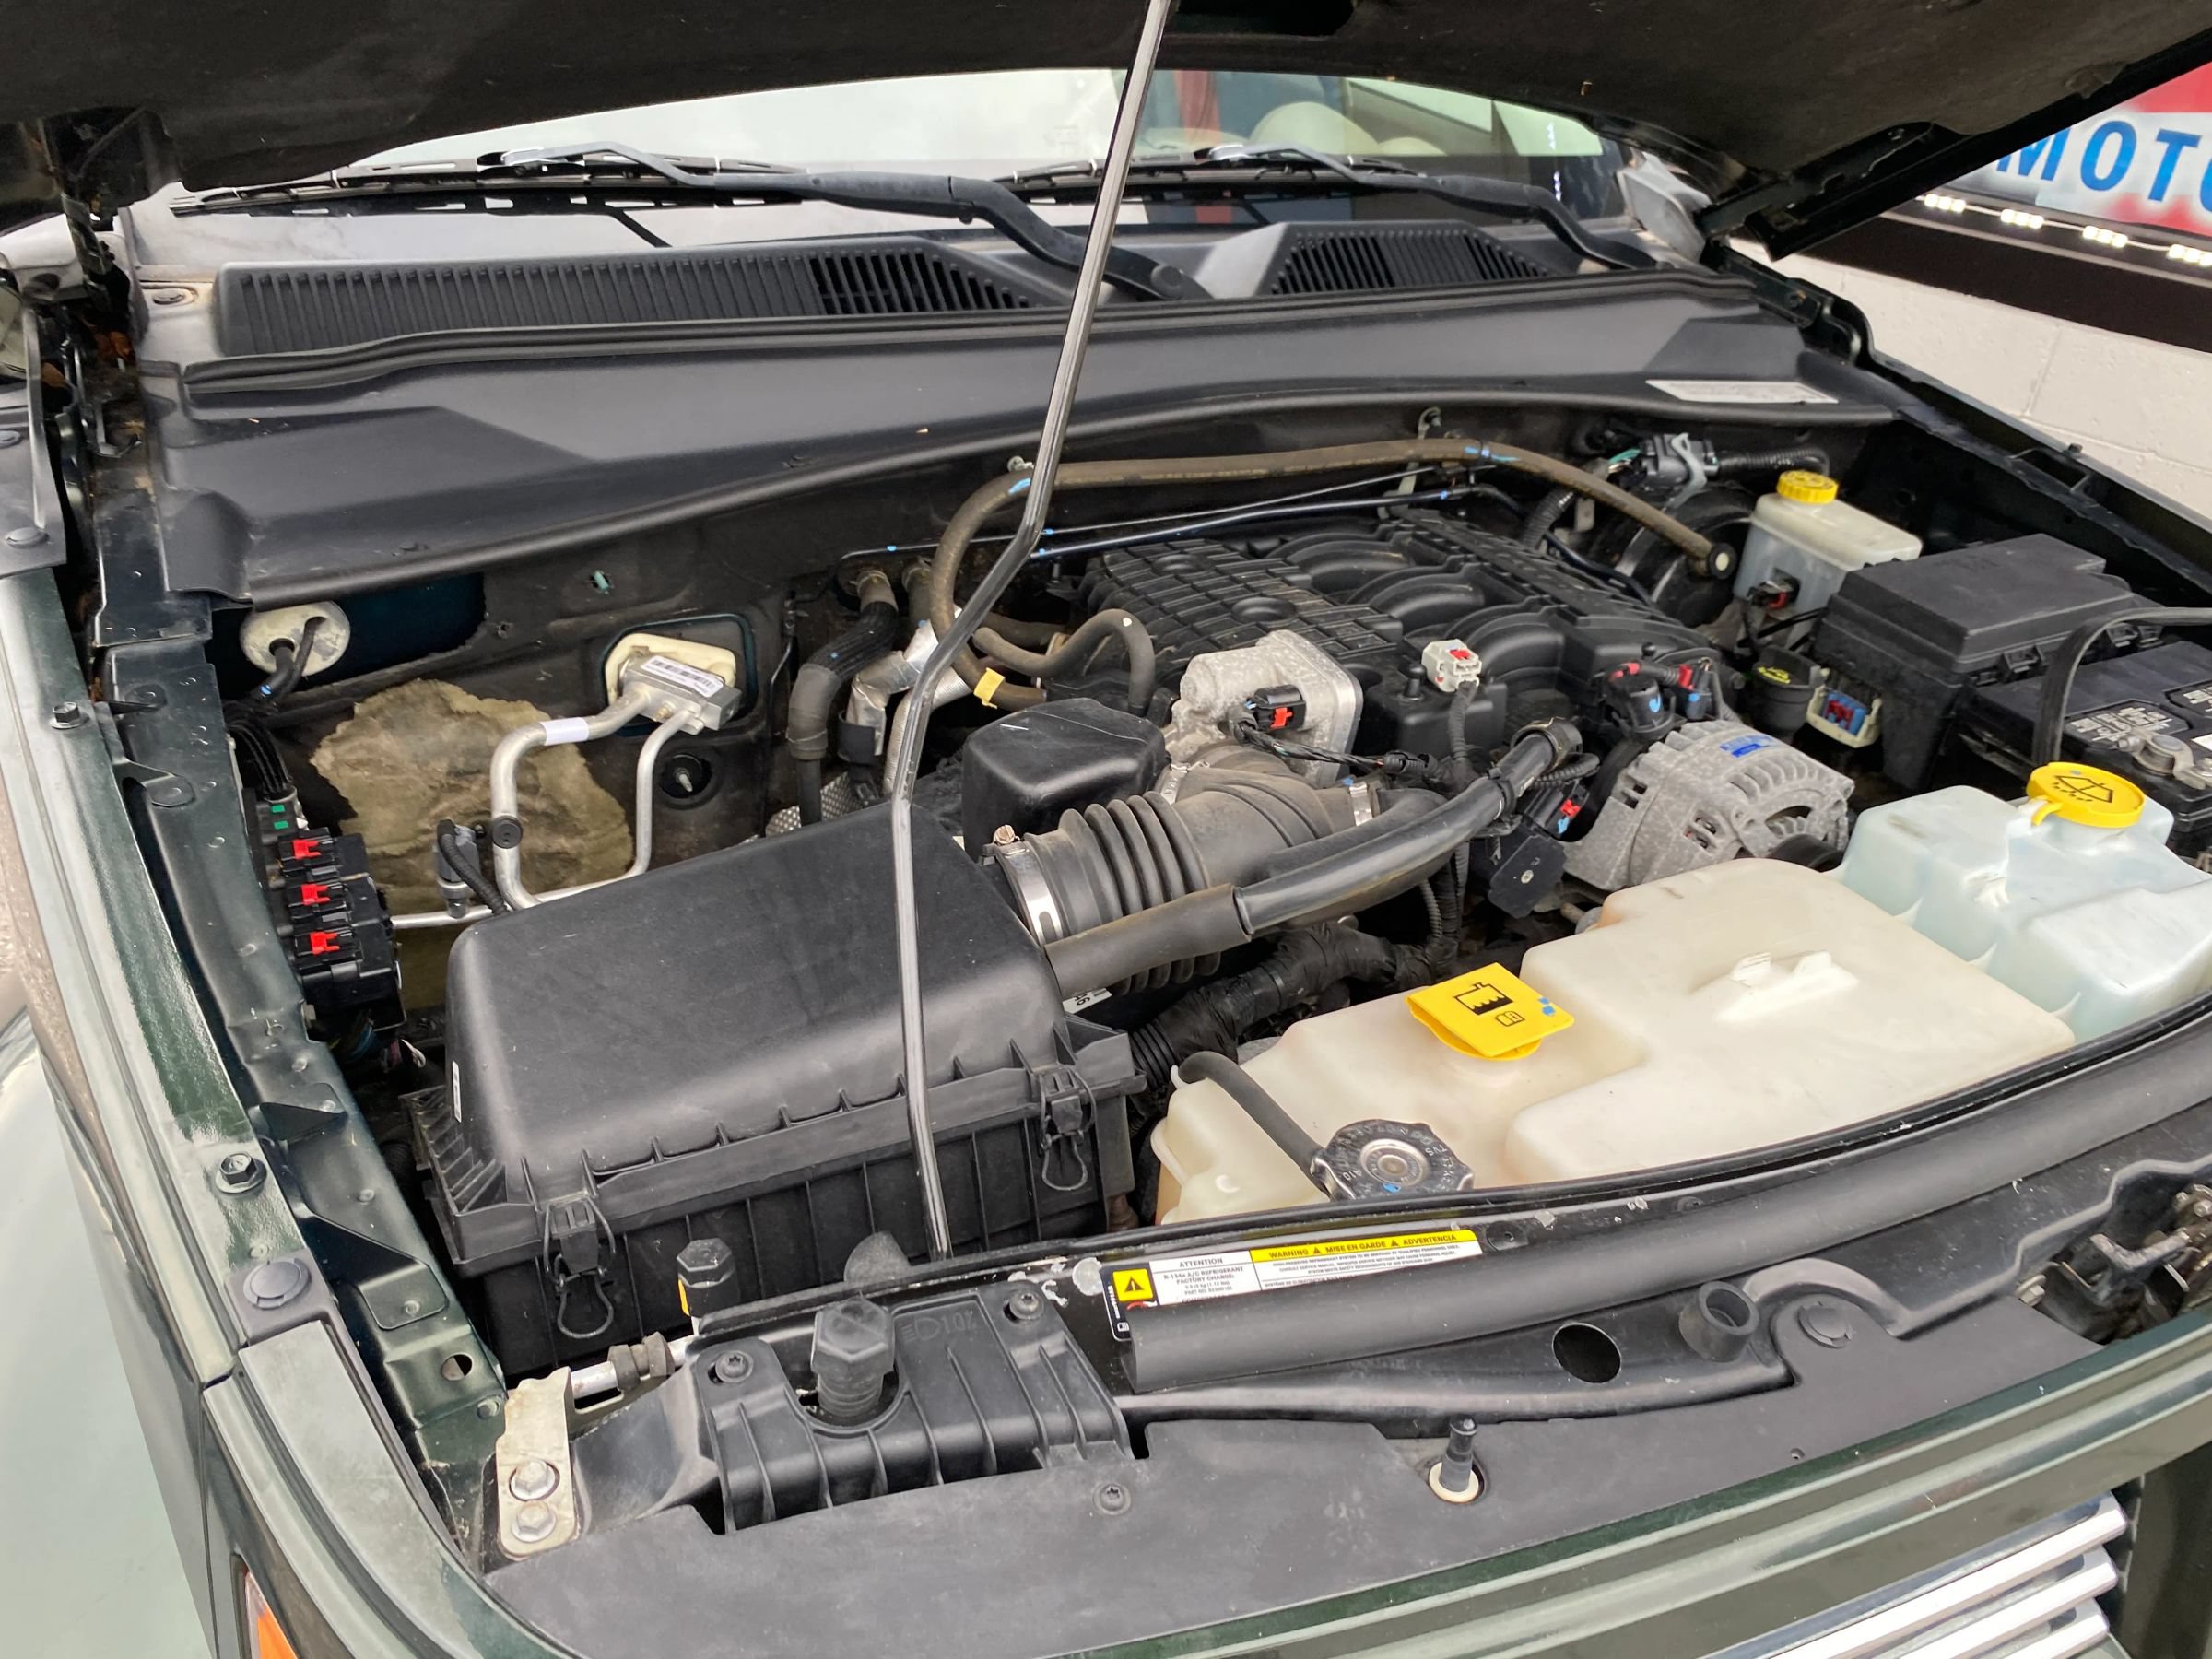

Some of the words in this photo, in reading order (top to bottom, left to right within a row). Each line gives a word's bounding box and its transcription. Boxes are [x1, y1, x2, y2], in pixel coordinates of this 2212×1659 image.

[1996, 121, 2212, 213] MOT
[1403, 1234, 1457, 1245] ADVERTENCIA
[1325, 1244, 1345, 1253] MISE
[1347, 1243, 1359, 1252] EN
[1359, 1241, 1386, 1250] GARDE
[1269, 1248, 1309, 1259] WARNING
[1179, 1257, 1223, 1268] ATTENTION
[1201, 1266, 1244, 1276] REFRIGERANT
[1176, 1276, 1206, 1285] FACTORY
